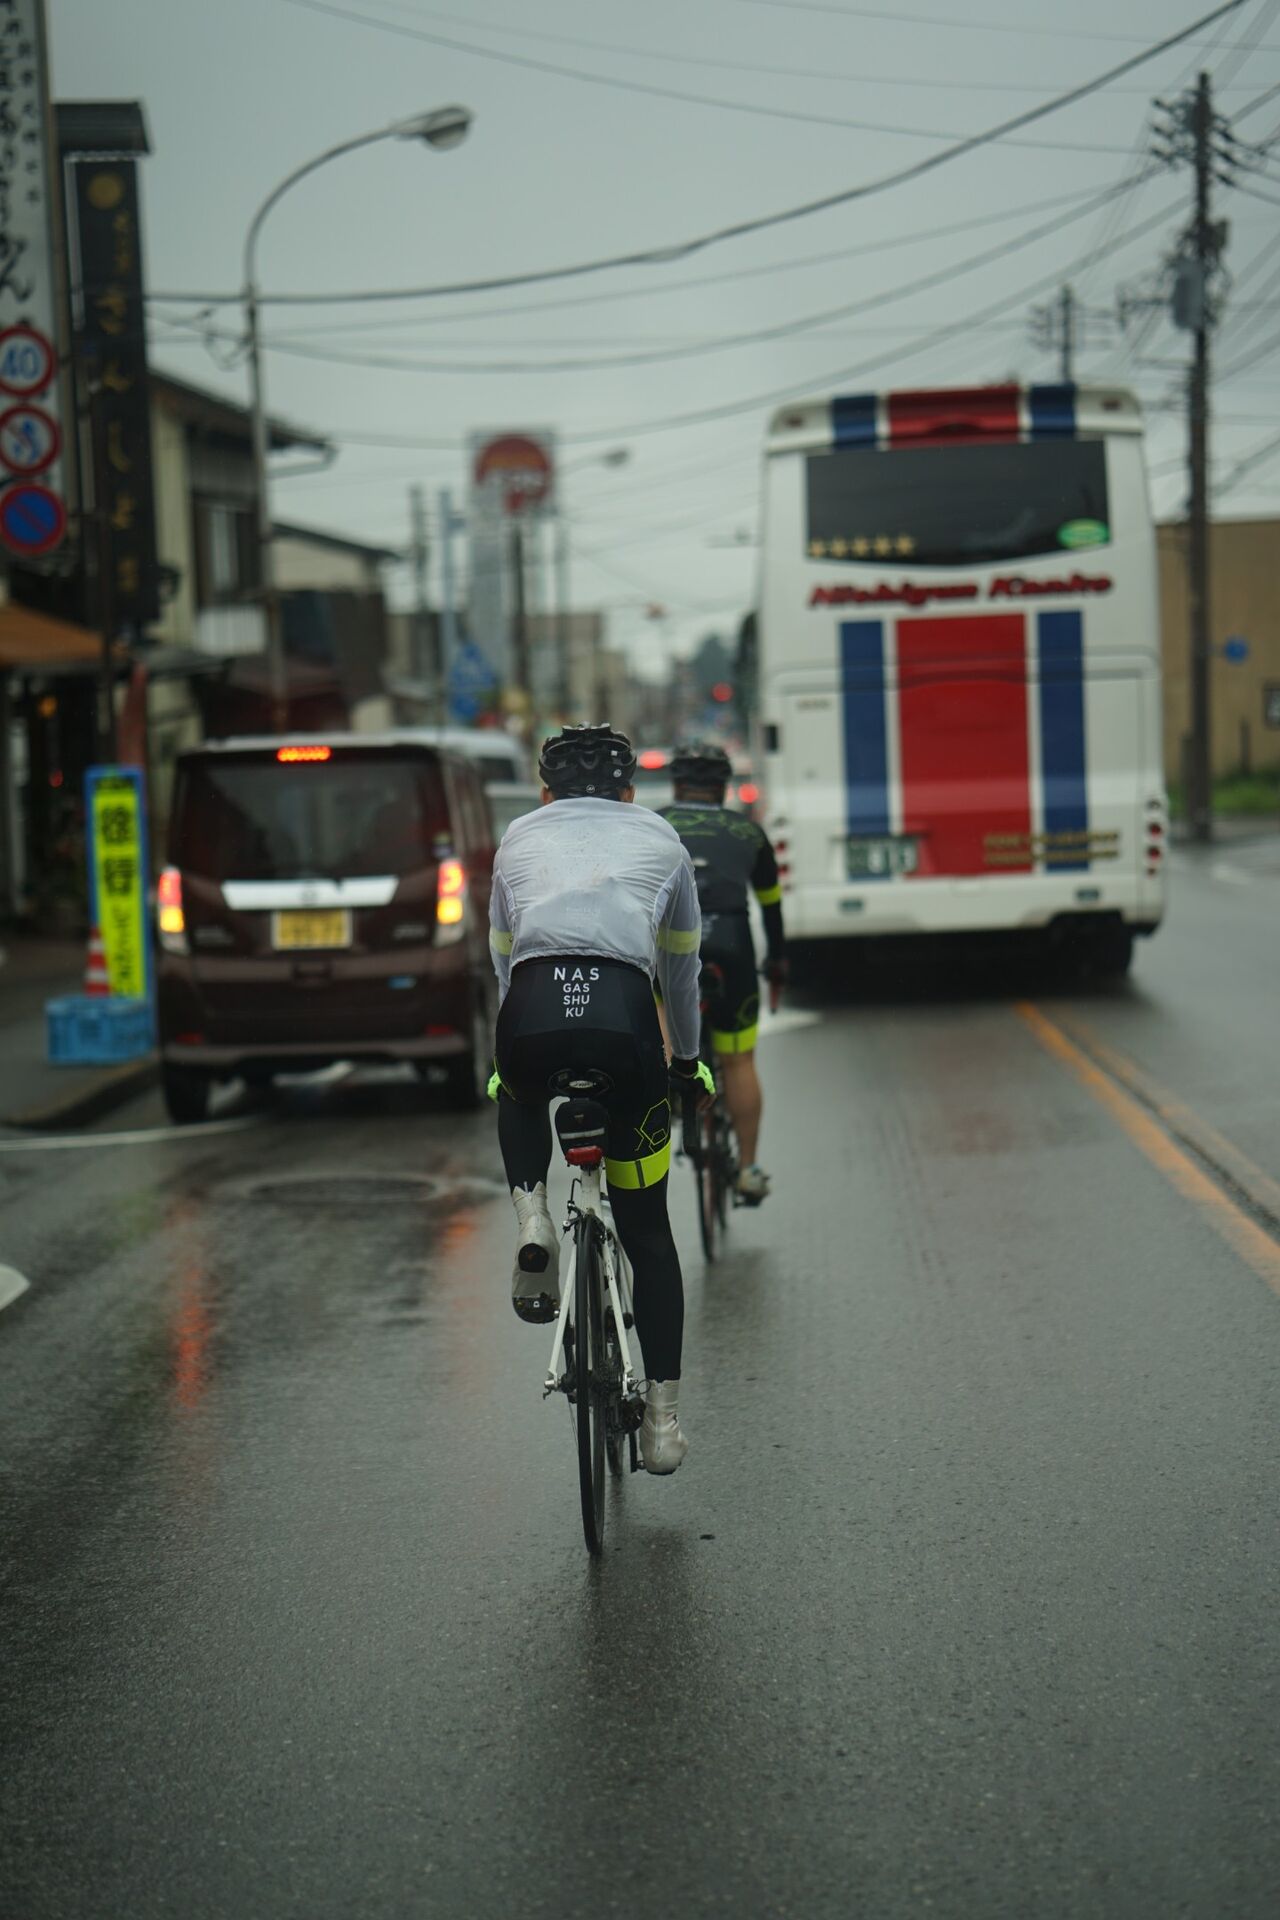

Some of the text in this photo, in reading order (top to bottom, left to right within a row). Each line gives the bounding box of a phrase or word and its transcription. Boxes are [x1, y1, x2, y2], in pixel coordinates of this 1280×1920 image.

[1, 345, 42, 380] 40
[553, 967, 600, 981] NAS
[562, 983, 590, 993] GAS
[562, 995, 590, 1005] SHU
[565, 1007, 584, 1018] KU
